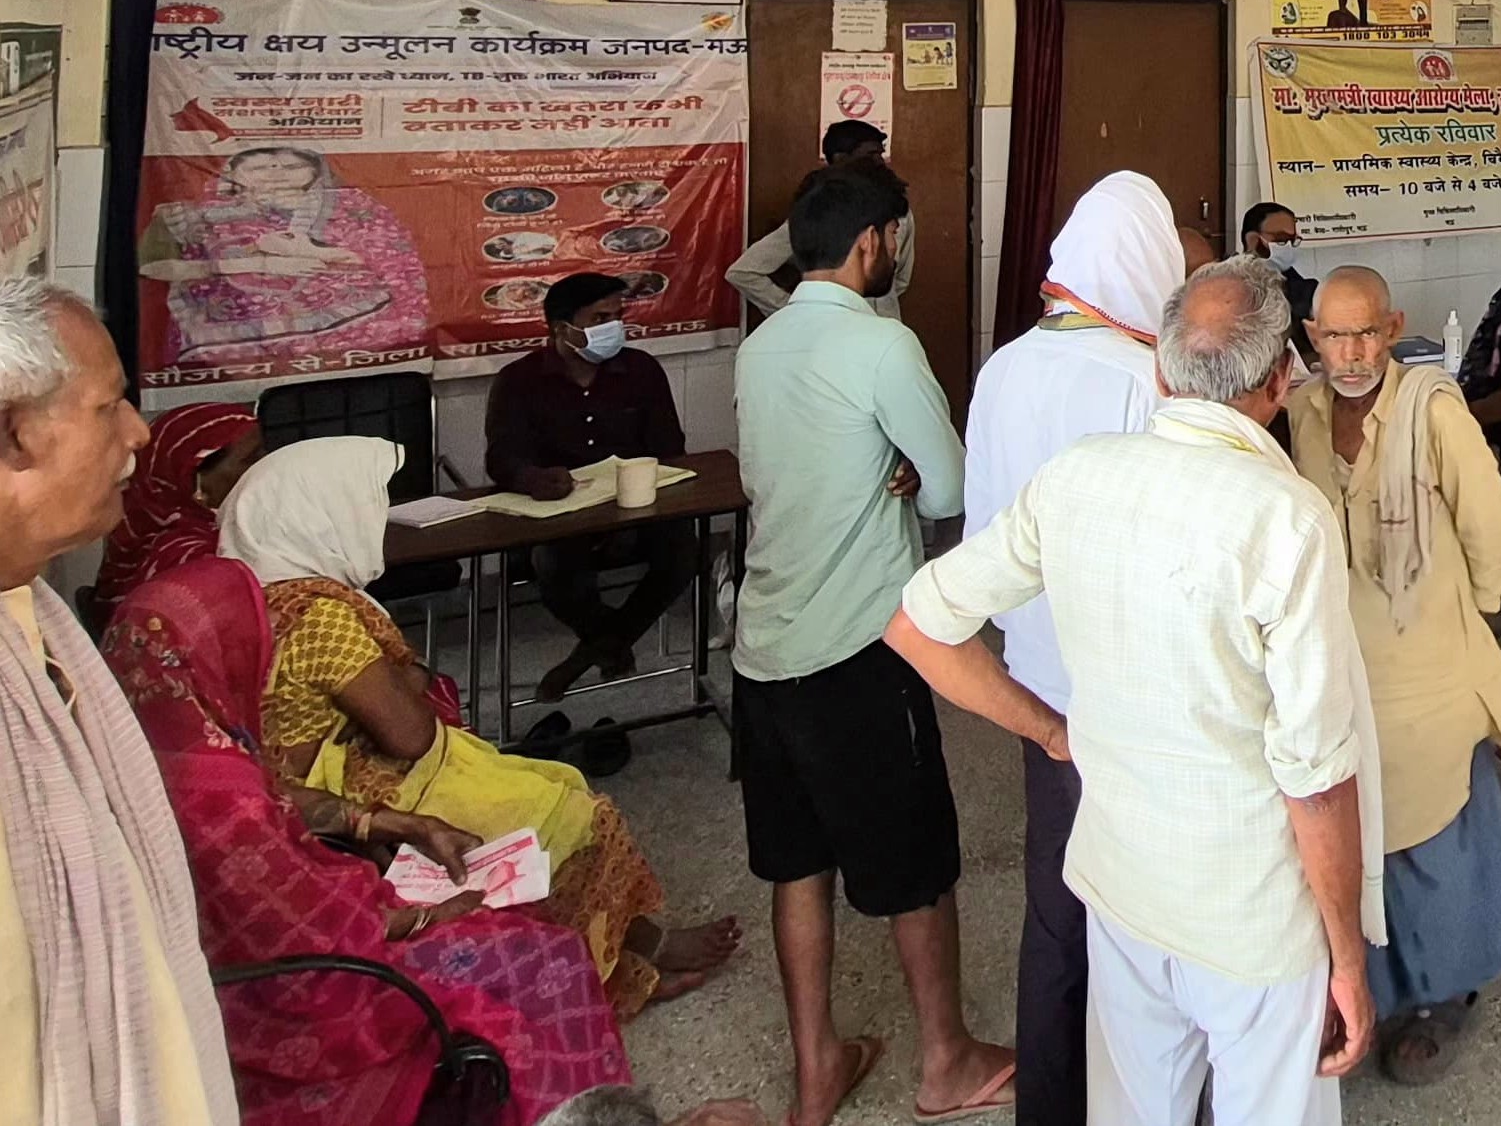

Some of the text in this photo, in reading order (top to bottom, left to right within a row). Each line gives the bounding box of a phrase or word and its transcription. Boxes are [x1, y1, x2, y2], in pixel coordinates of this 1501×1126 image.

[149, 26, 248, 59] ाष्ट्रीय
[264, 34, 327, 53] क्षय
[341, 34, 457, 60] उन्मूलन
[469, 31, 590, 56] कार्यक्रम
[486, 100, 531, 113] का
[1375, 119, 1497, 147] प्रत्येक रविवार
[1332, 154, 1393, 173] प्राथमिक
[1399, 181, 1418, 195] 10
[1451, 175, 1463, 191] से
[1468, 179, 1476, 192] 4
